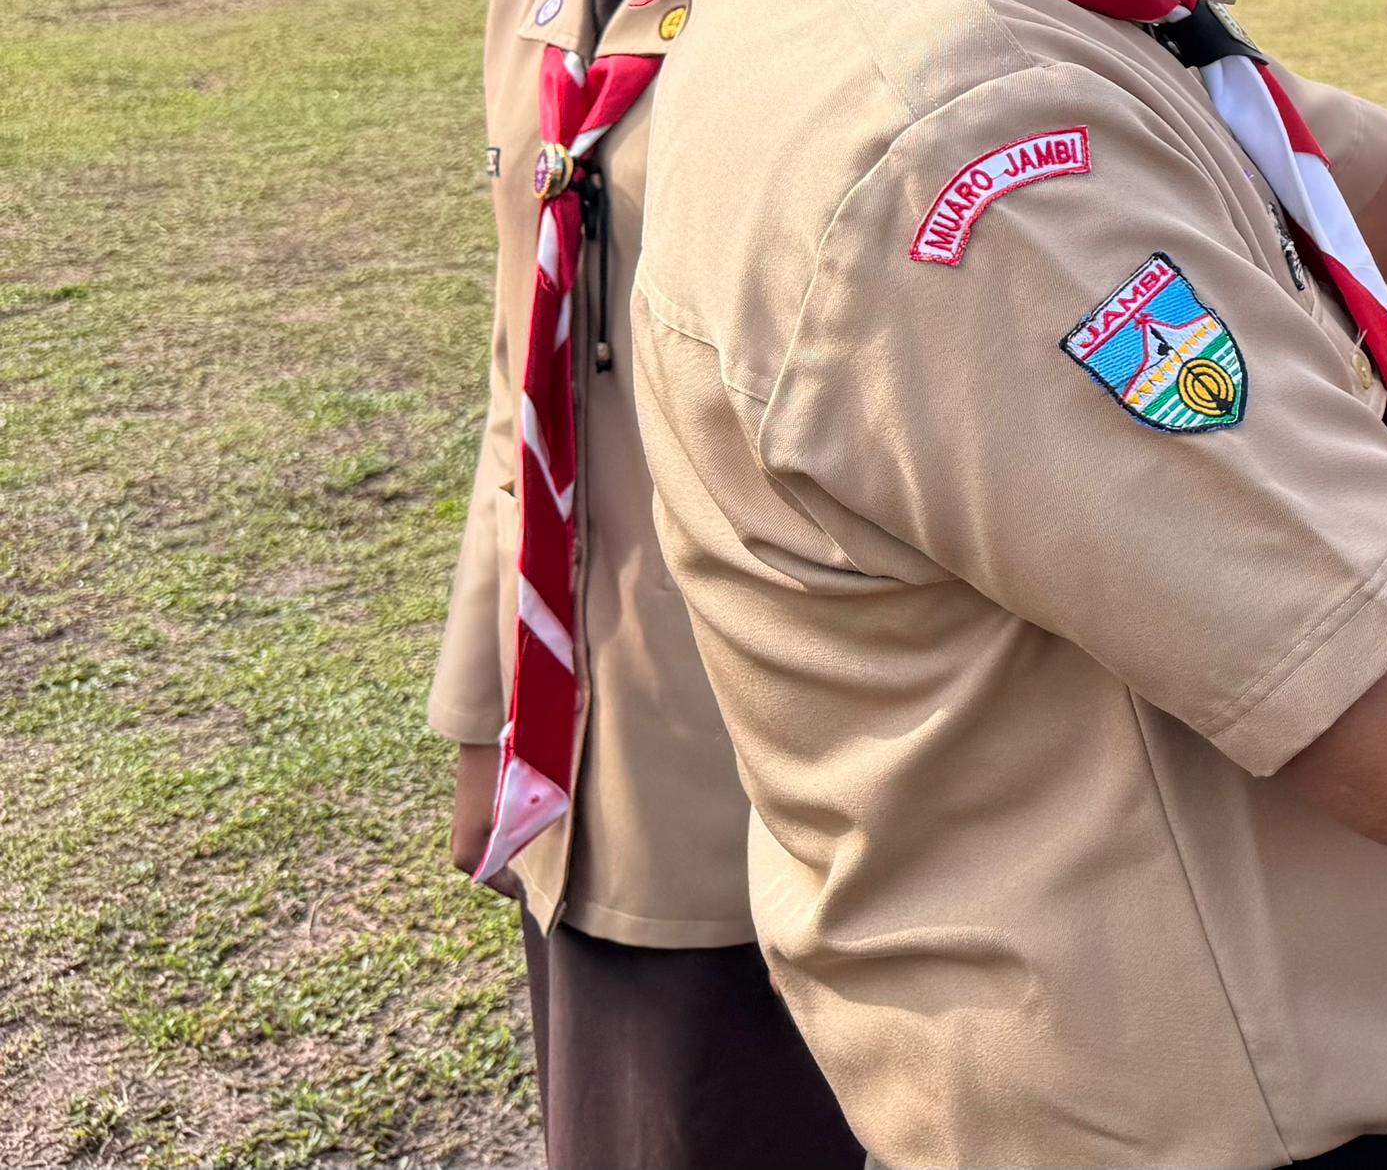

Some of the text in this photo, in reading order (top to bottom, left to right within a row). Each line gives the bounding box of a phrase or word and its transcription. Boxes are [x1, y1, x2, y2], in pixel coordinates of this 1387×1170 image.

[924, 138, 1078, 253] MUARO JAMBI
[1079, 263, 1169, 349] JAMBI
